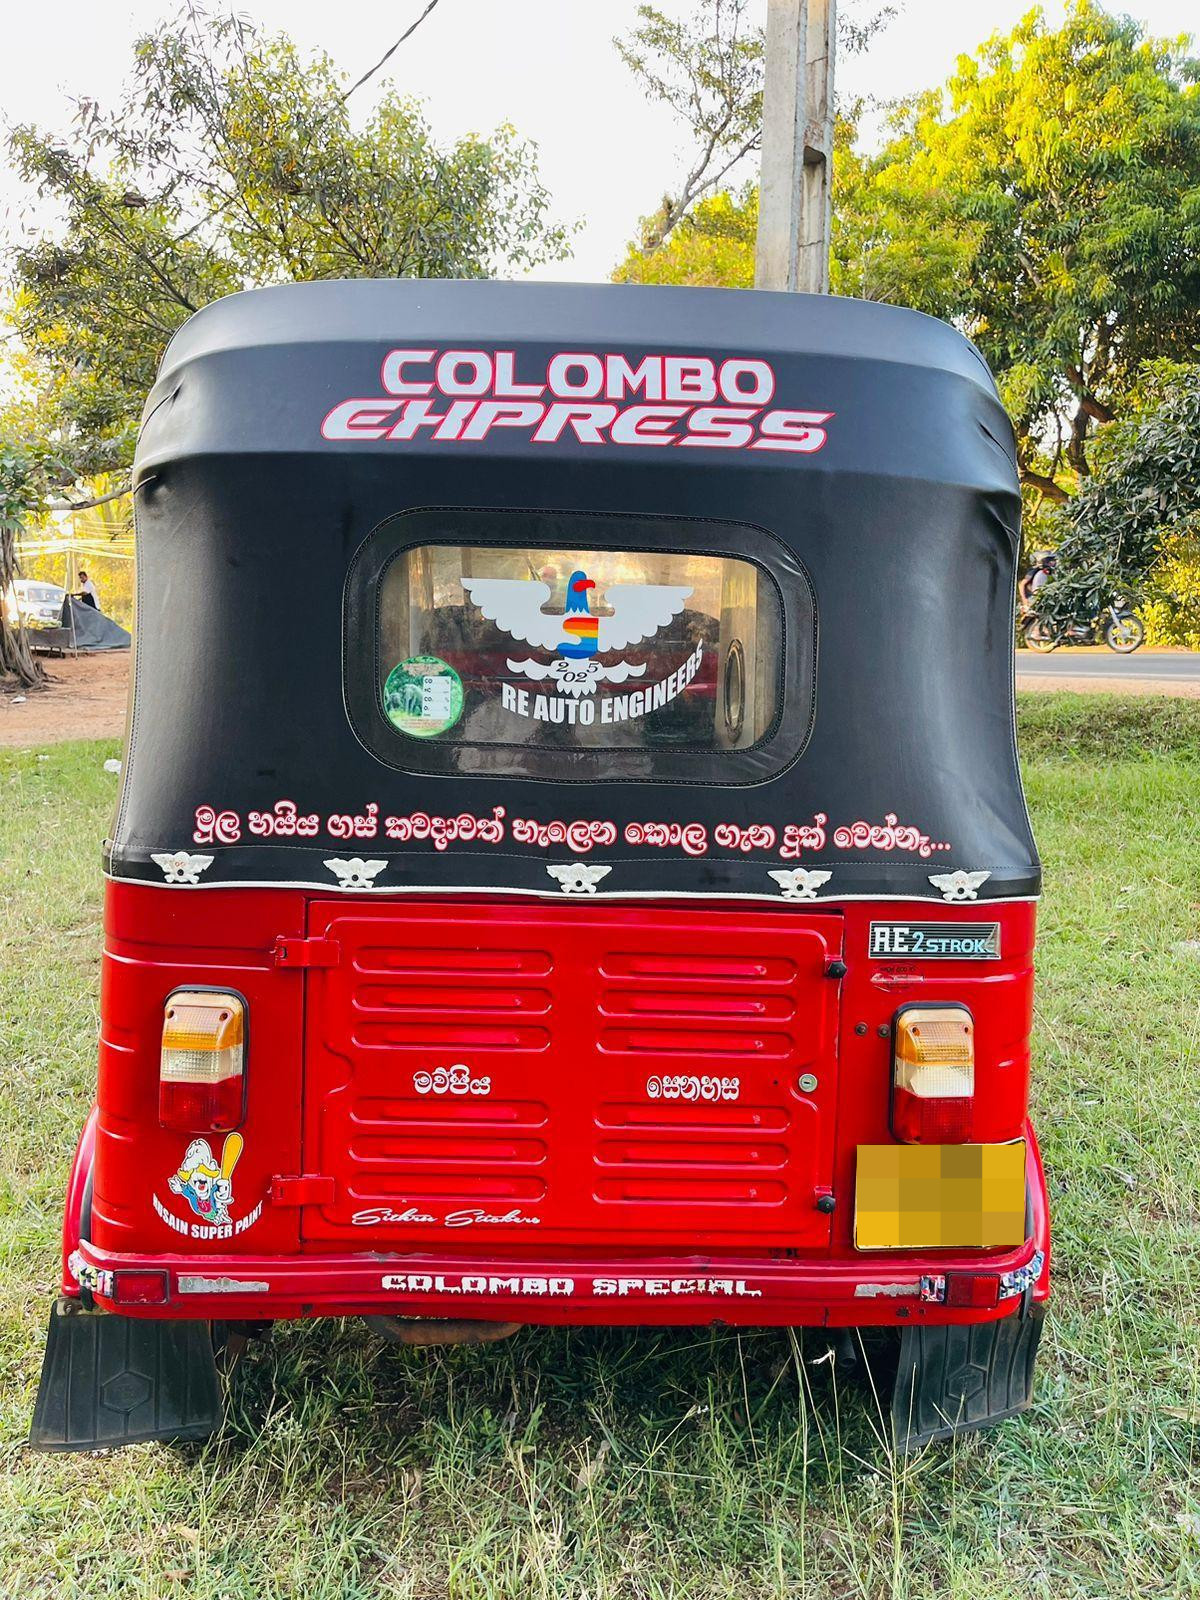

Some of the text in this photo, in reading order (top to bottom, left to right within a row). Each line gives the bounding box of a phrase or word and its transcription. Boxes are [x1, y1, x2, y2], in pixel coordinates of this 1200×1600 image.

[380, 348, 775, 404] COLOMBO
[319, 398, 836, 453] EXPRESS
[502, 638, 704, 725] RE AUTO ENGINEERS
[326, 802, 380, 839] ගස්
[714, 821, 777, 852] ගැන
[191, 1223, 233, 1239] SUPER
[235, 1200, 263, 1235] PAINT
[381, 1274, 763, 1298] COLOMBO SPECIAL
